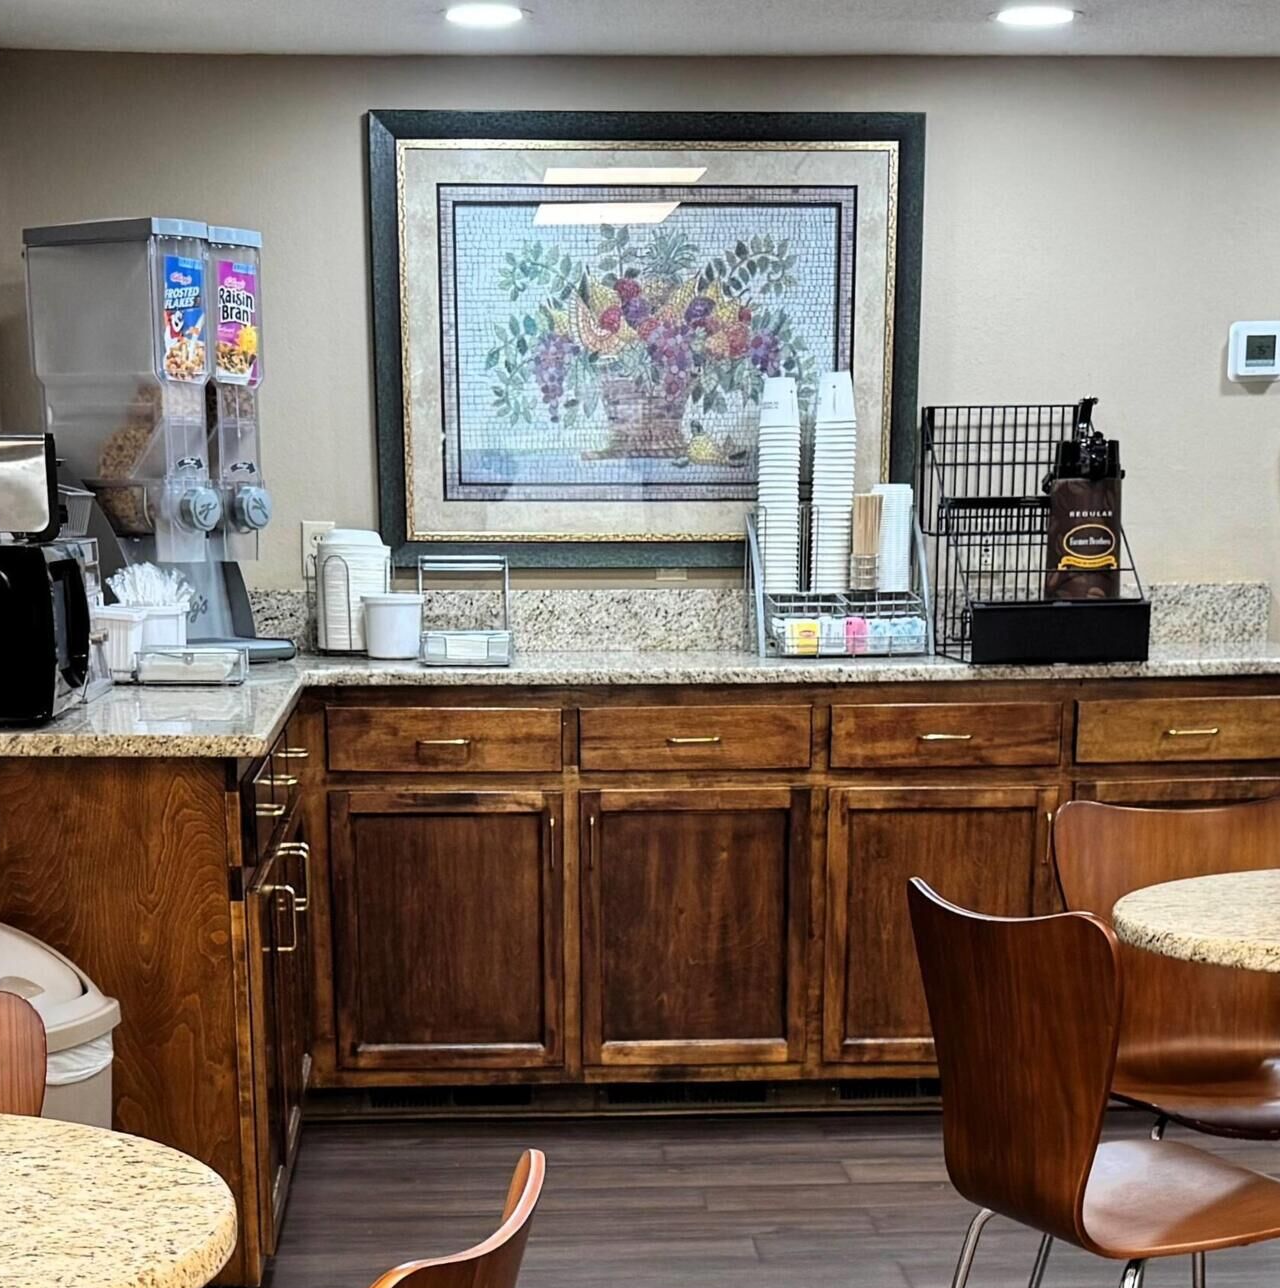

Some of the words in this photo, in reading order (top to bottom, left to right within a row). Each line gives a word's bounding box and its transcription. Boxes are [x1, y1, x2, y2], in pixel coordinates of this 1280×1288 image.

[164, 286, 200, 299] FROSTED
[219, 287, 253, 310] Raisin
[164, 297, 195, 310] FLAKES
[221, 304, 250, 323] Bran
[1069, 510, 1113, 518] REGULAR
